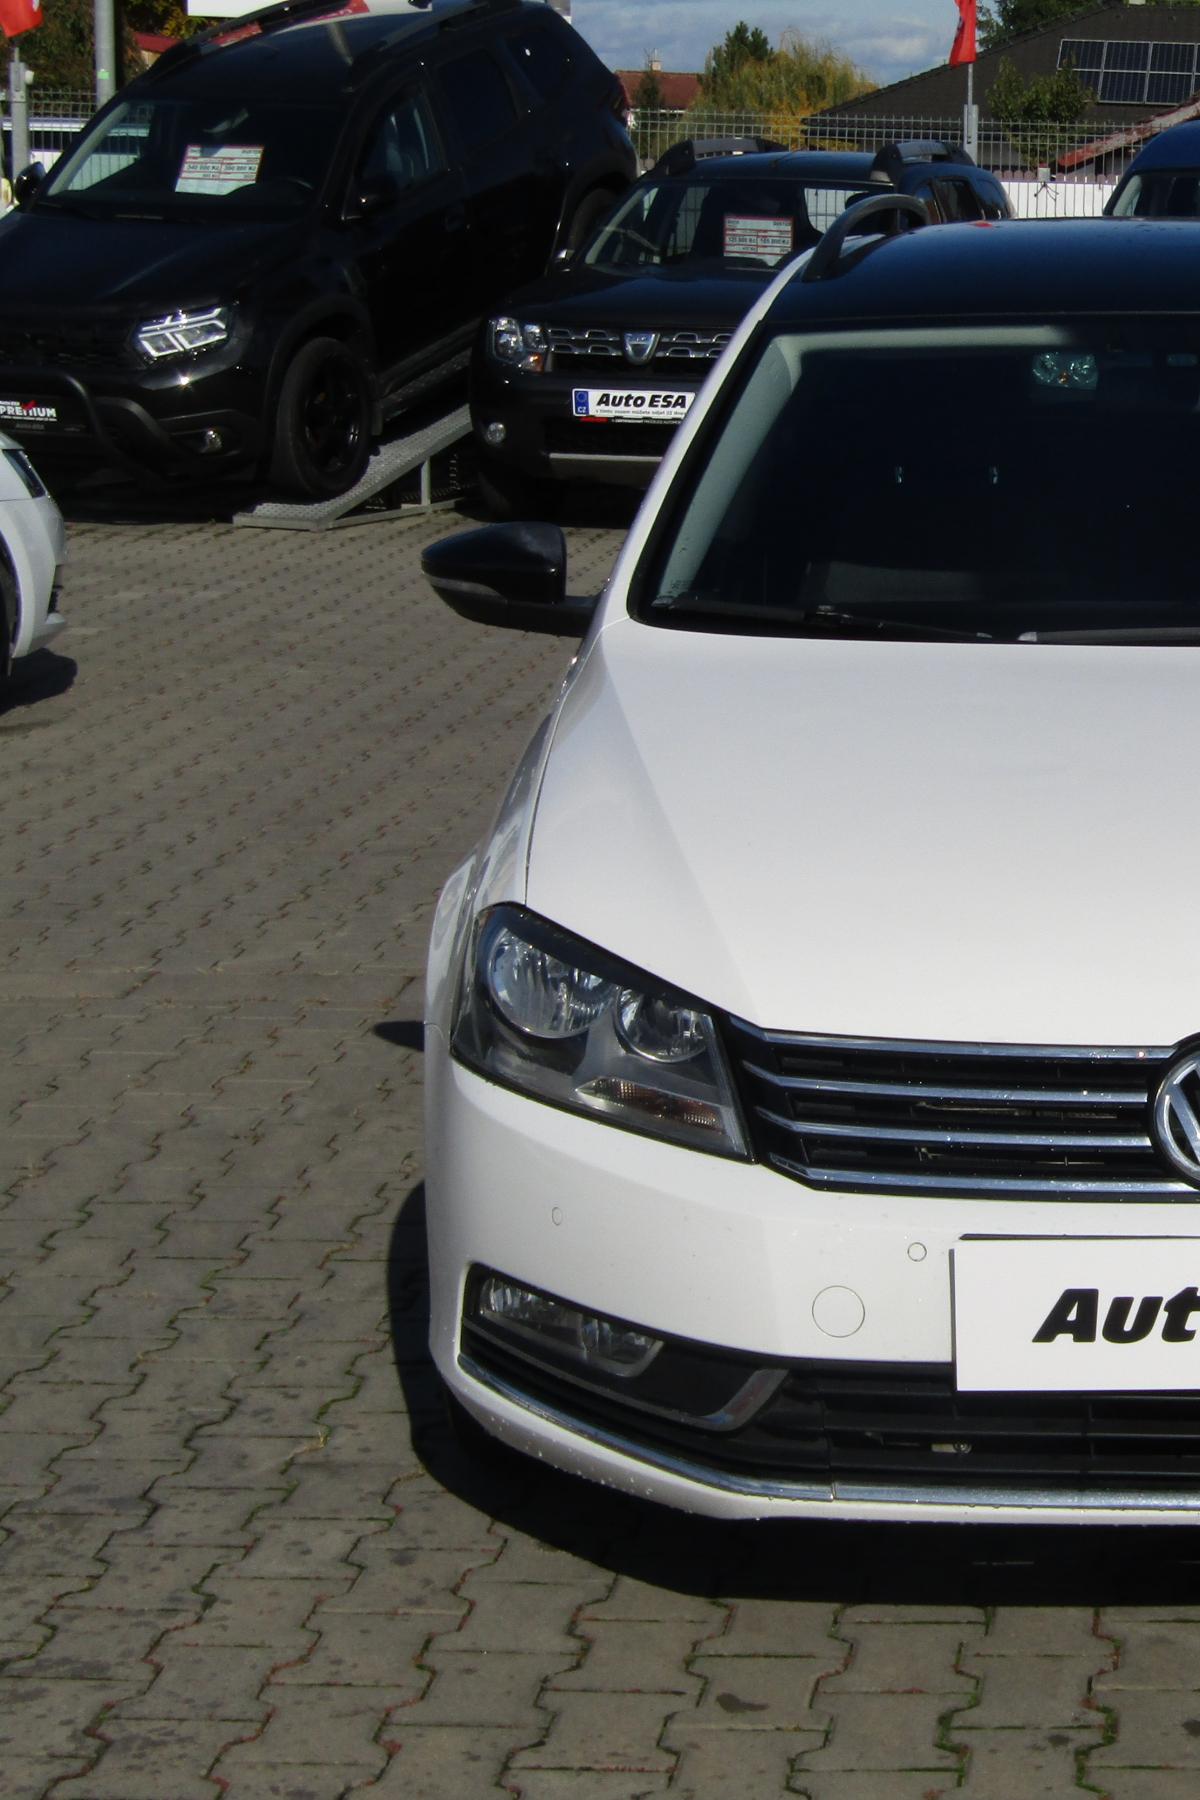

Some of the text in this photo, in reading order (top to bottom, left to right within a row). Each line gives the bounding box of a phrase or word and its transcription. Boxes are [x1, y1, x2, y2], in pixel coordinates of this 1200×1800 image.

[596, 393, 687, 409] Auto ESA
[0, 405, 56, 417] PREMIUM
